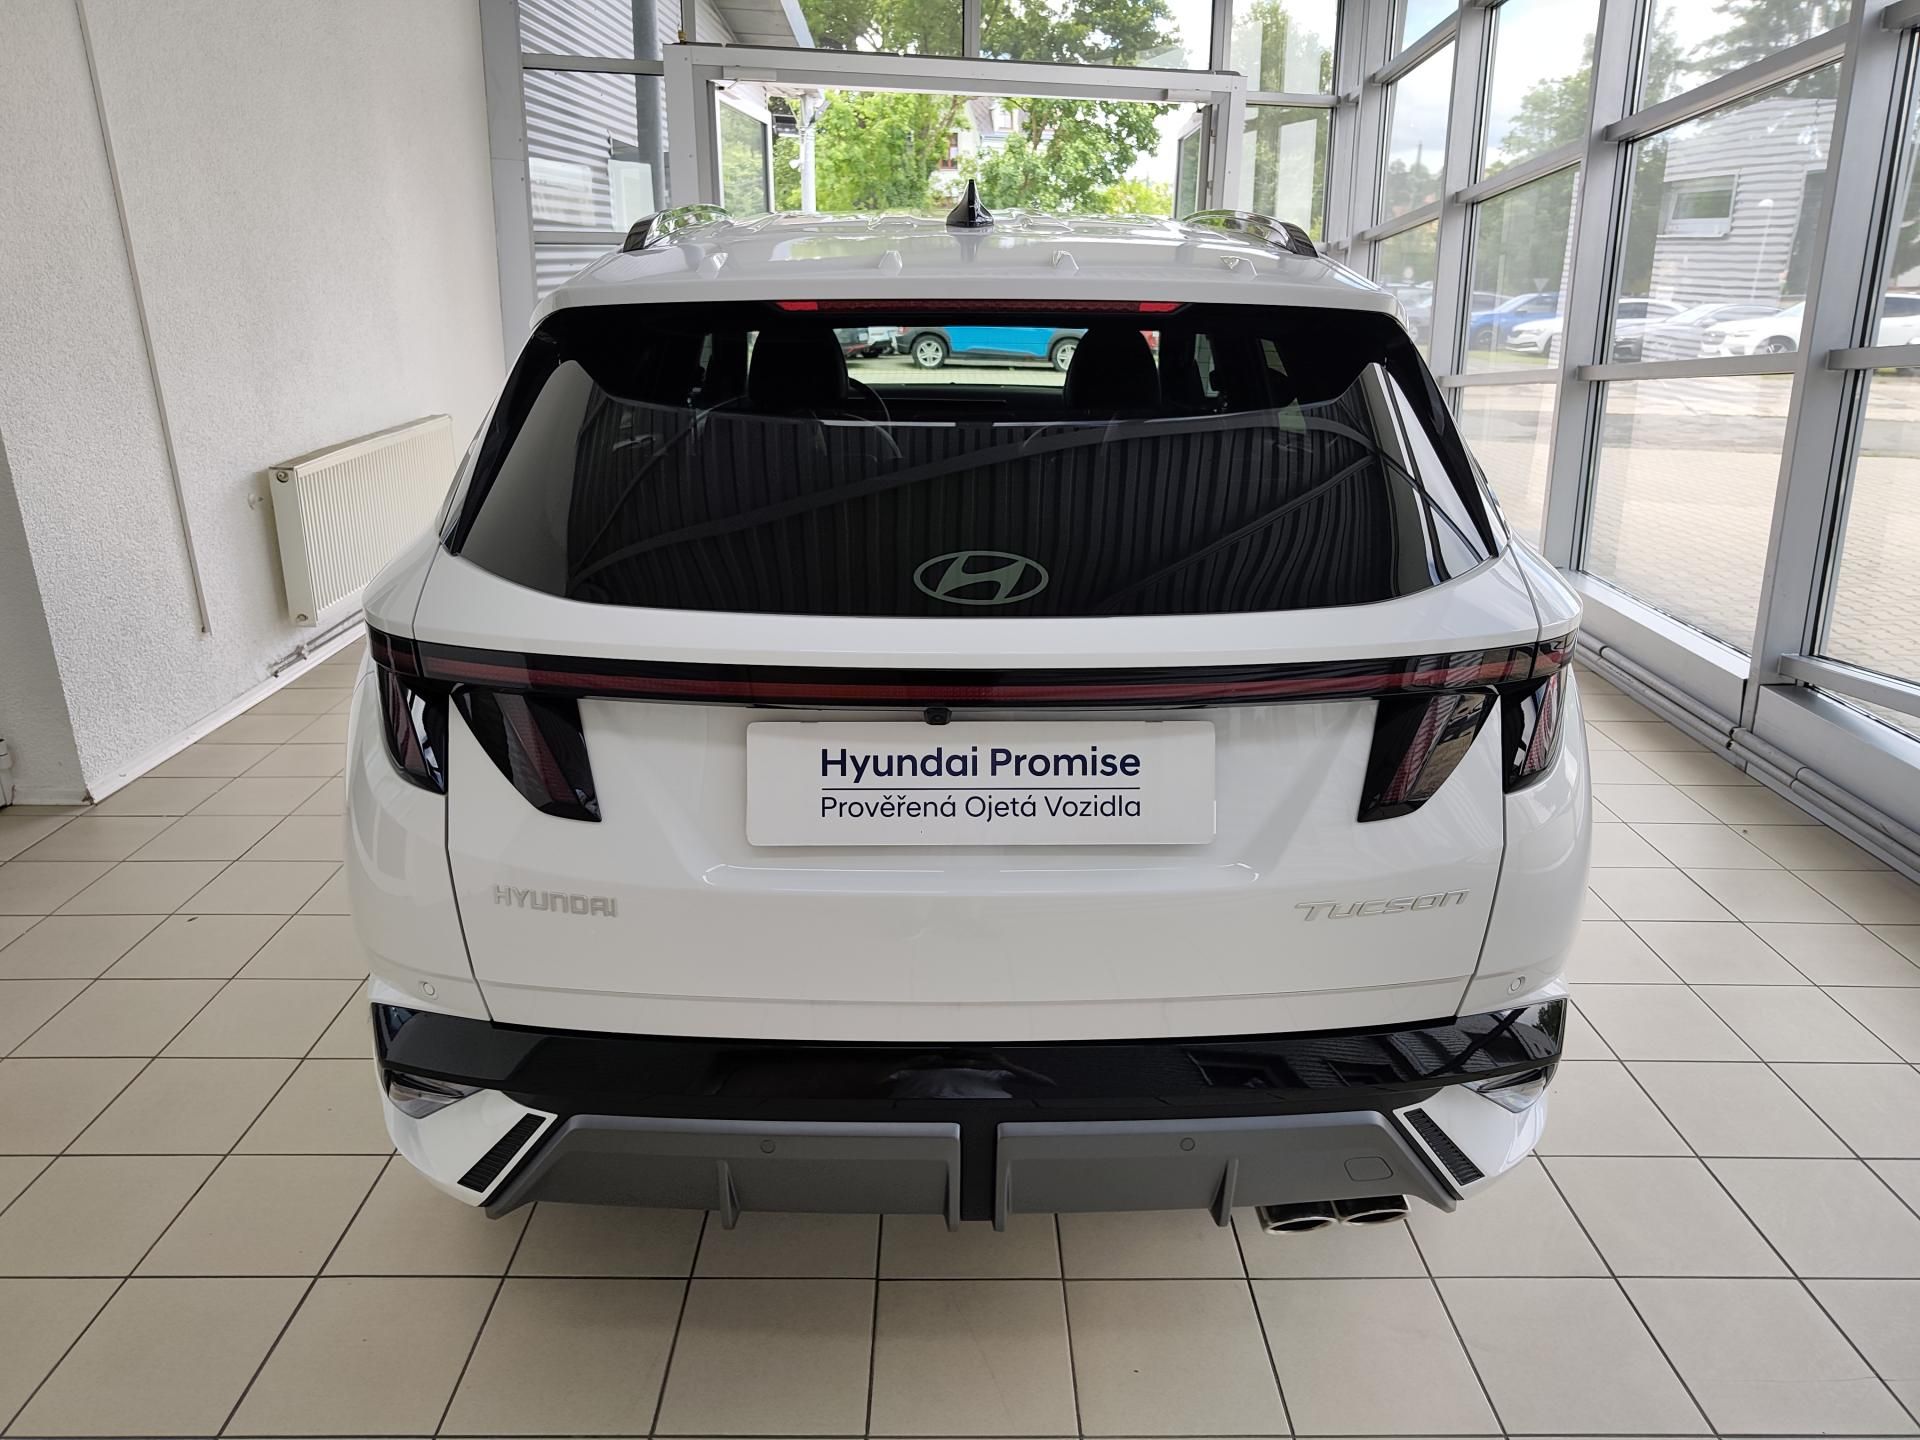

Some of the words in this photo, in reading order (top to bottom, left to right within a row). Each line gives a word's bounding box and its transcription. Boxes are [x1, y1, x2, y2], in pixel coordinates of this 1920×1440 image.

[821, 745, 978, 783] Hyundai
[990, 745, 1141, 777] Promise
[821, 794, 956, 818] Prověřená
[964, 794, 1037, 822] Ojetá
[1044, 794, 1141, 817] Vozidla
[494, 885, 617, 917] HYUNDAI
[1294, 888, 1470, 922] TUCSON
